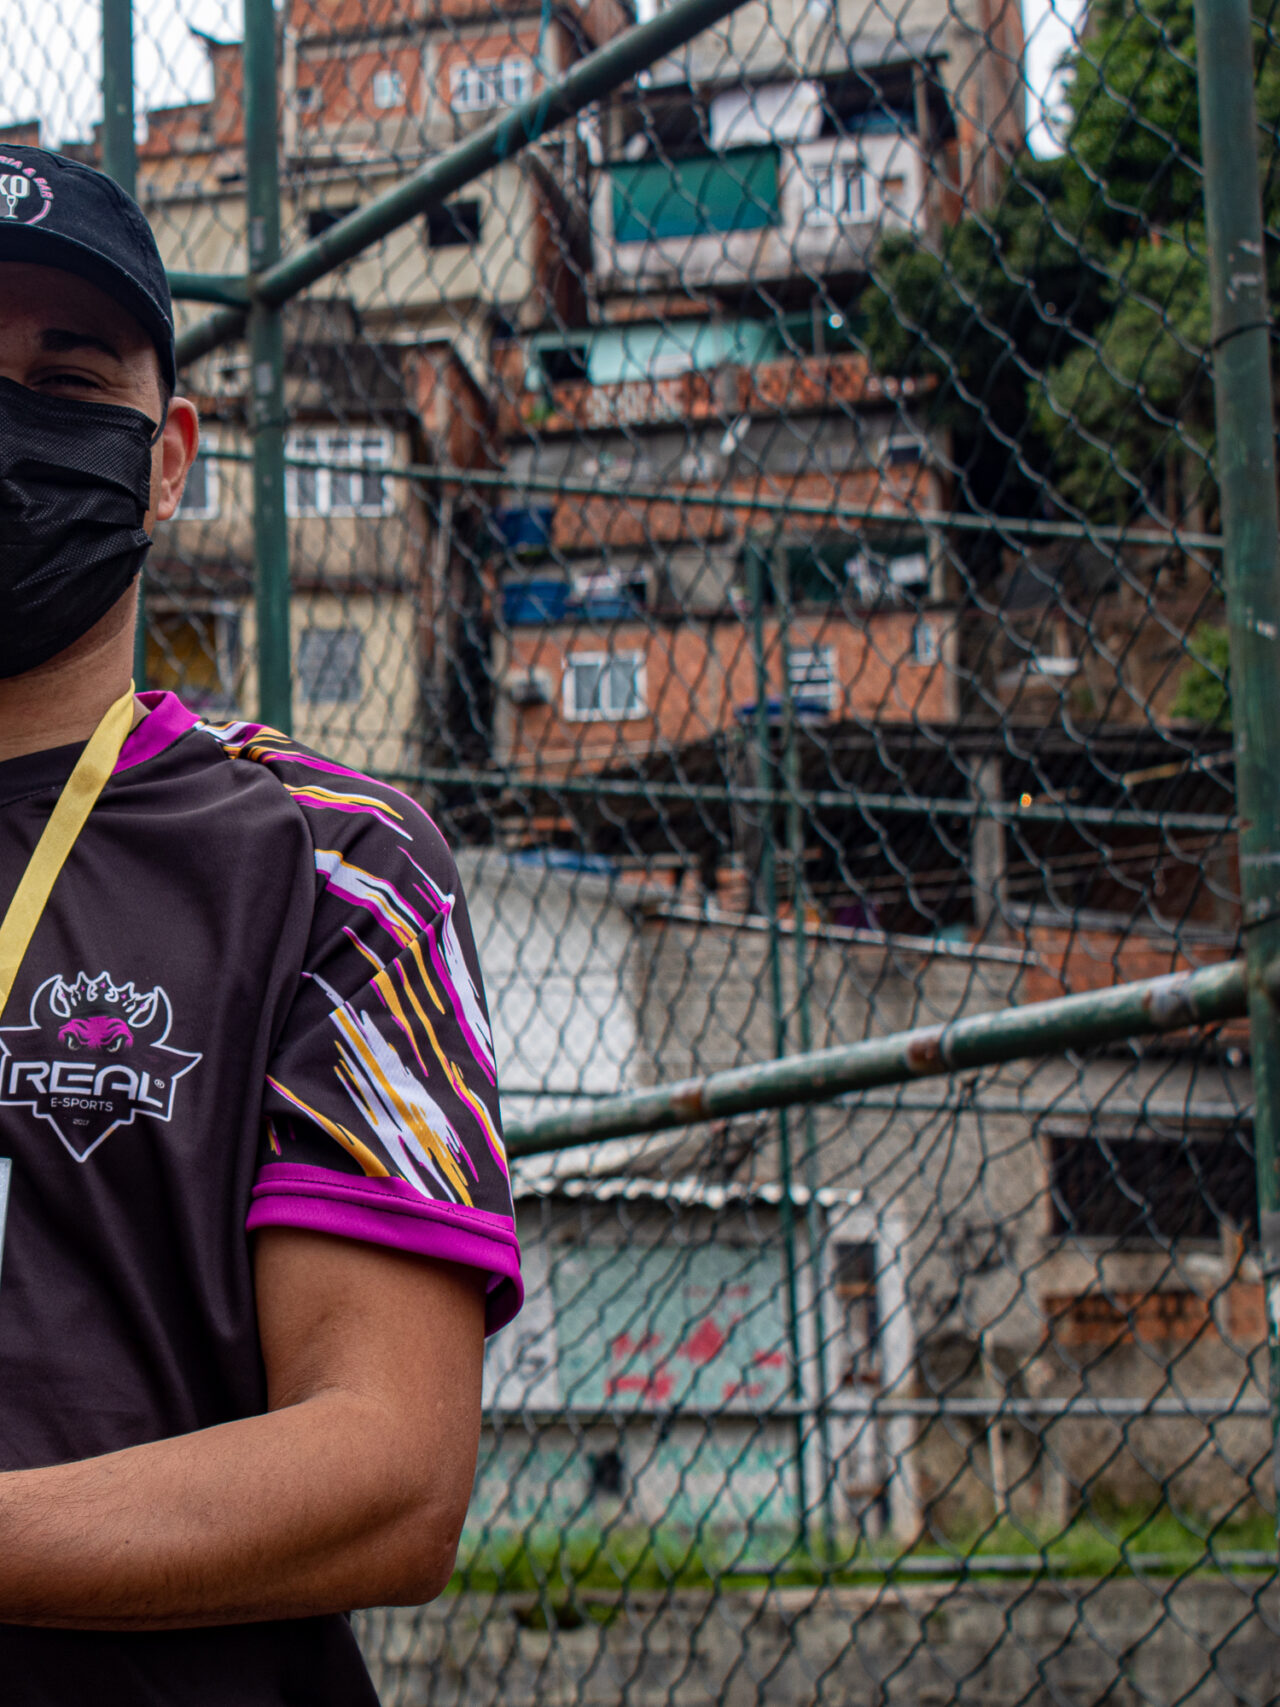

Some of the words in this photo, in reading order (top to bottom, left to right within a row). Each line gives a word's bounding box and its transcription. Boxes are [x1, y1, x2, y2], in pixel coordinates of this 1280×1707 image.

[32, 177, 54, 199] BAR
[8, 1060, 163, 1109] REAL
[50, 1096, 114, 1112] E-SPORTS
